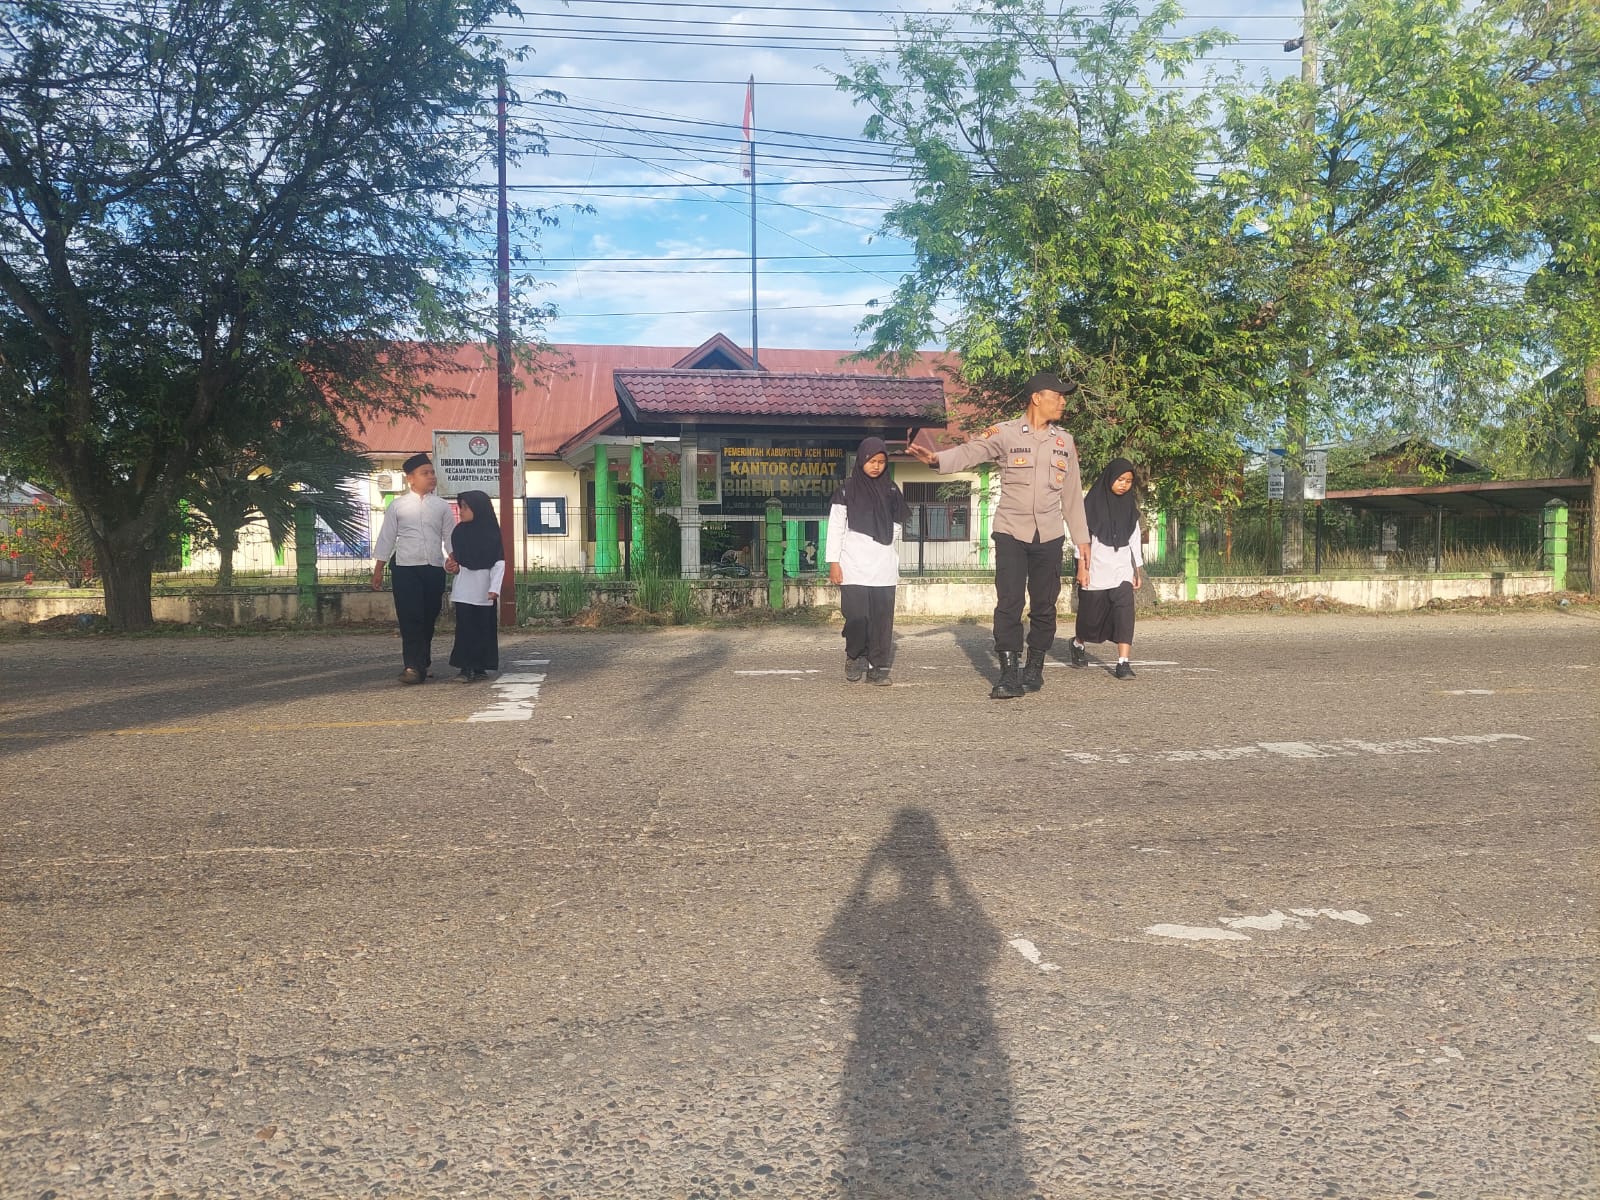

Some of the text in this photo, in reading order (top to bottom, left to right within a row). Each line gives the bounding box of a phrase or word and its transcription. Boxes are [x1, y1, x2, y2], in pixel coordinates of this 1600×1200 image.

[724, 447, 843, 457] PEMERINTAH KABUPATEN ACEH TIMUR
[441, 458, 464, 466] DHARMA
[465, 459, 486, 467] WANITA
[730, 461, 837, 476] KANTOR CAMAT
[725, 479, 775, 497] BIREM
